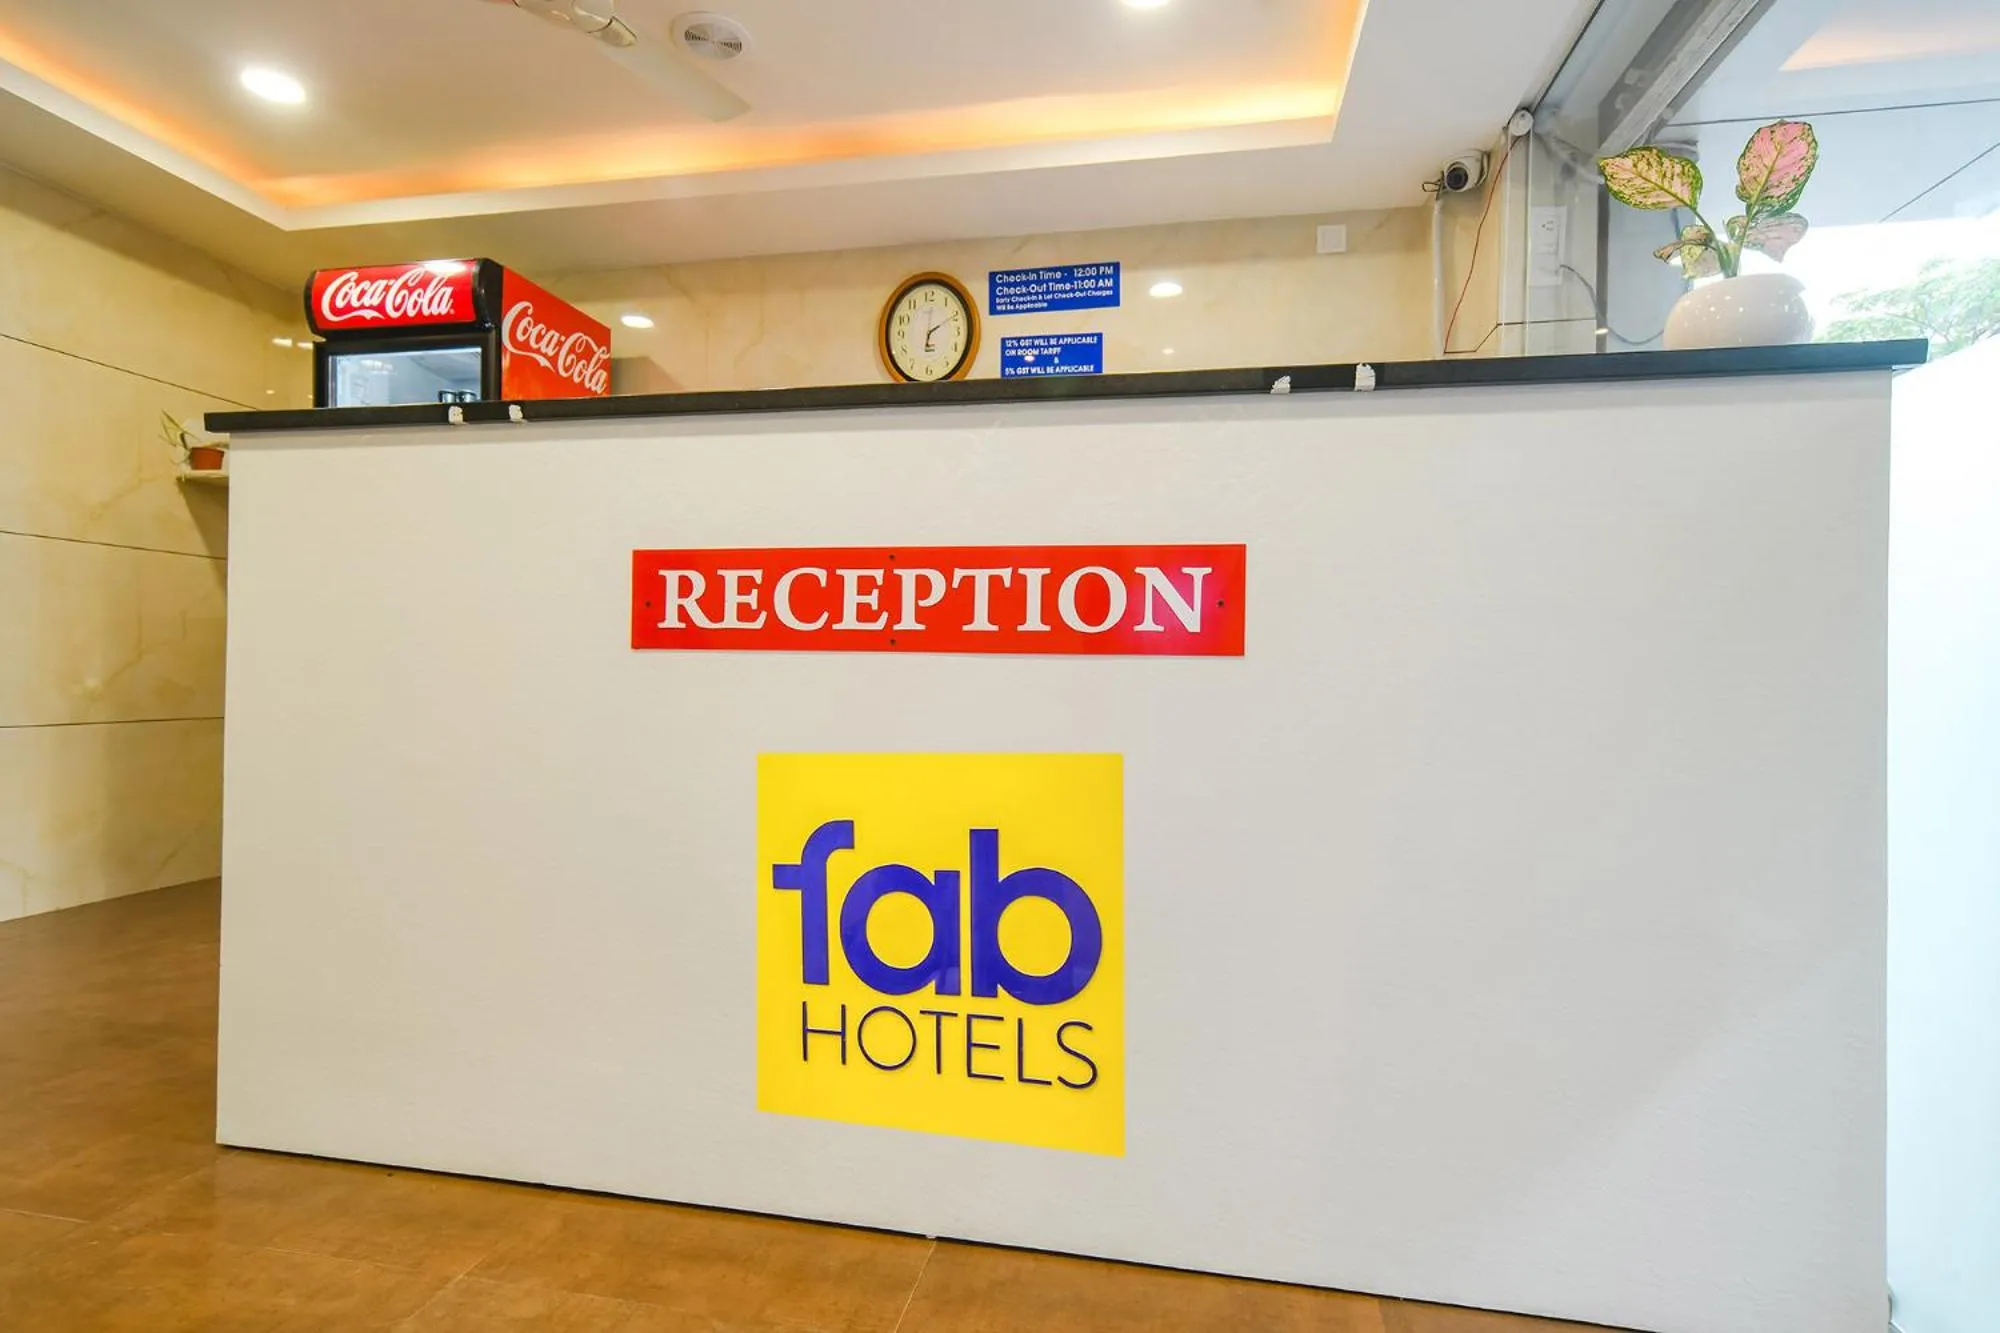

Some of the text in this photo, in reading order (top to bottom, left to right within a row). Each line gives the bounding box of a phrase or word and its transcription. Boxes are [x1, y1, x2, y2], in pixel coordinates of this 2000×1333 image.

[1040, 270, 1062, 280] Time
[1073, 267, 1097, 277] 12:00
[1099, 266, 1114, 276] PM
[996, 283, 1046, 296] Check-Out
[1098, 278, 1114, 288] AM
[321, 269, 455, 322] Coca-Cola
[924, 290, 936, 302] 12
[908, 299, 917, 310] 11
[899, 314, 910, 326] 10
[501, 301, 611, 394] Coca-Cola
[1005, 339, 1018, 348] 12%
[1034, 338, 1048, 346] WILL
[1049, 337, 1058, 345] BE
[1058, 336, 1098, 345] APPLICABLE
[1017, 348, 1040, 356] ROOM
[1016, 367, 1029, 375] GST
[1029, 366, 1045, 374] WILL
[1046, 366, 1055, 374] BE
[1056, 364, 1095, 373] APPLICABLE
[657, 566, 1212, 634] RECEPTION
[772, 819, 1103, 1006] fab
[802, 1001, 1099, 1090] HOTELS
